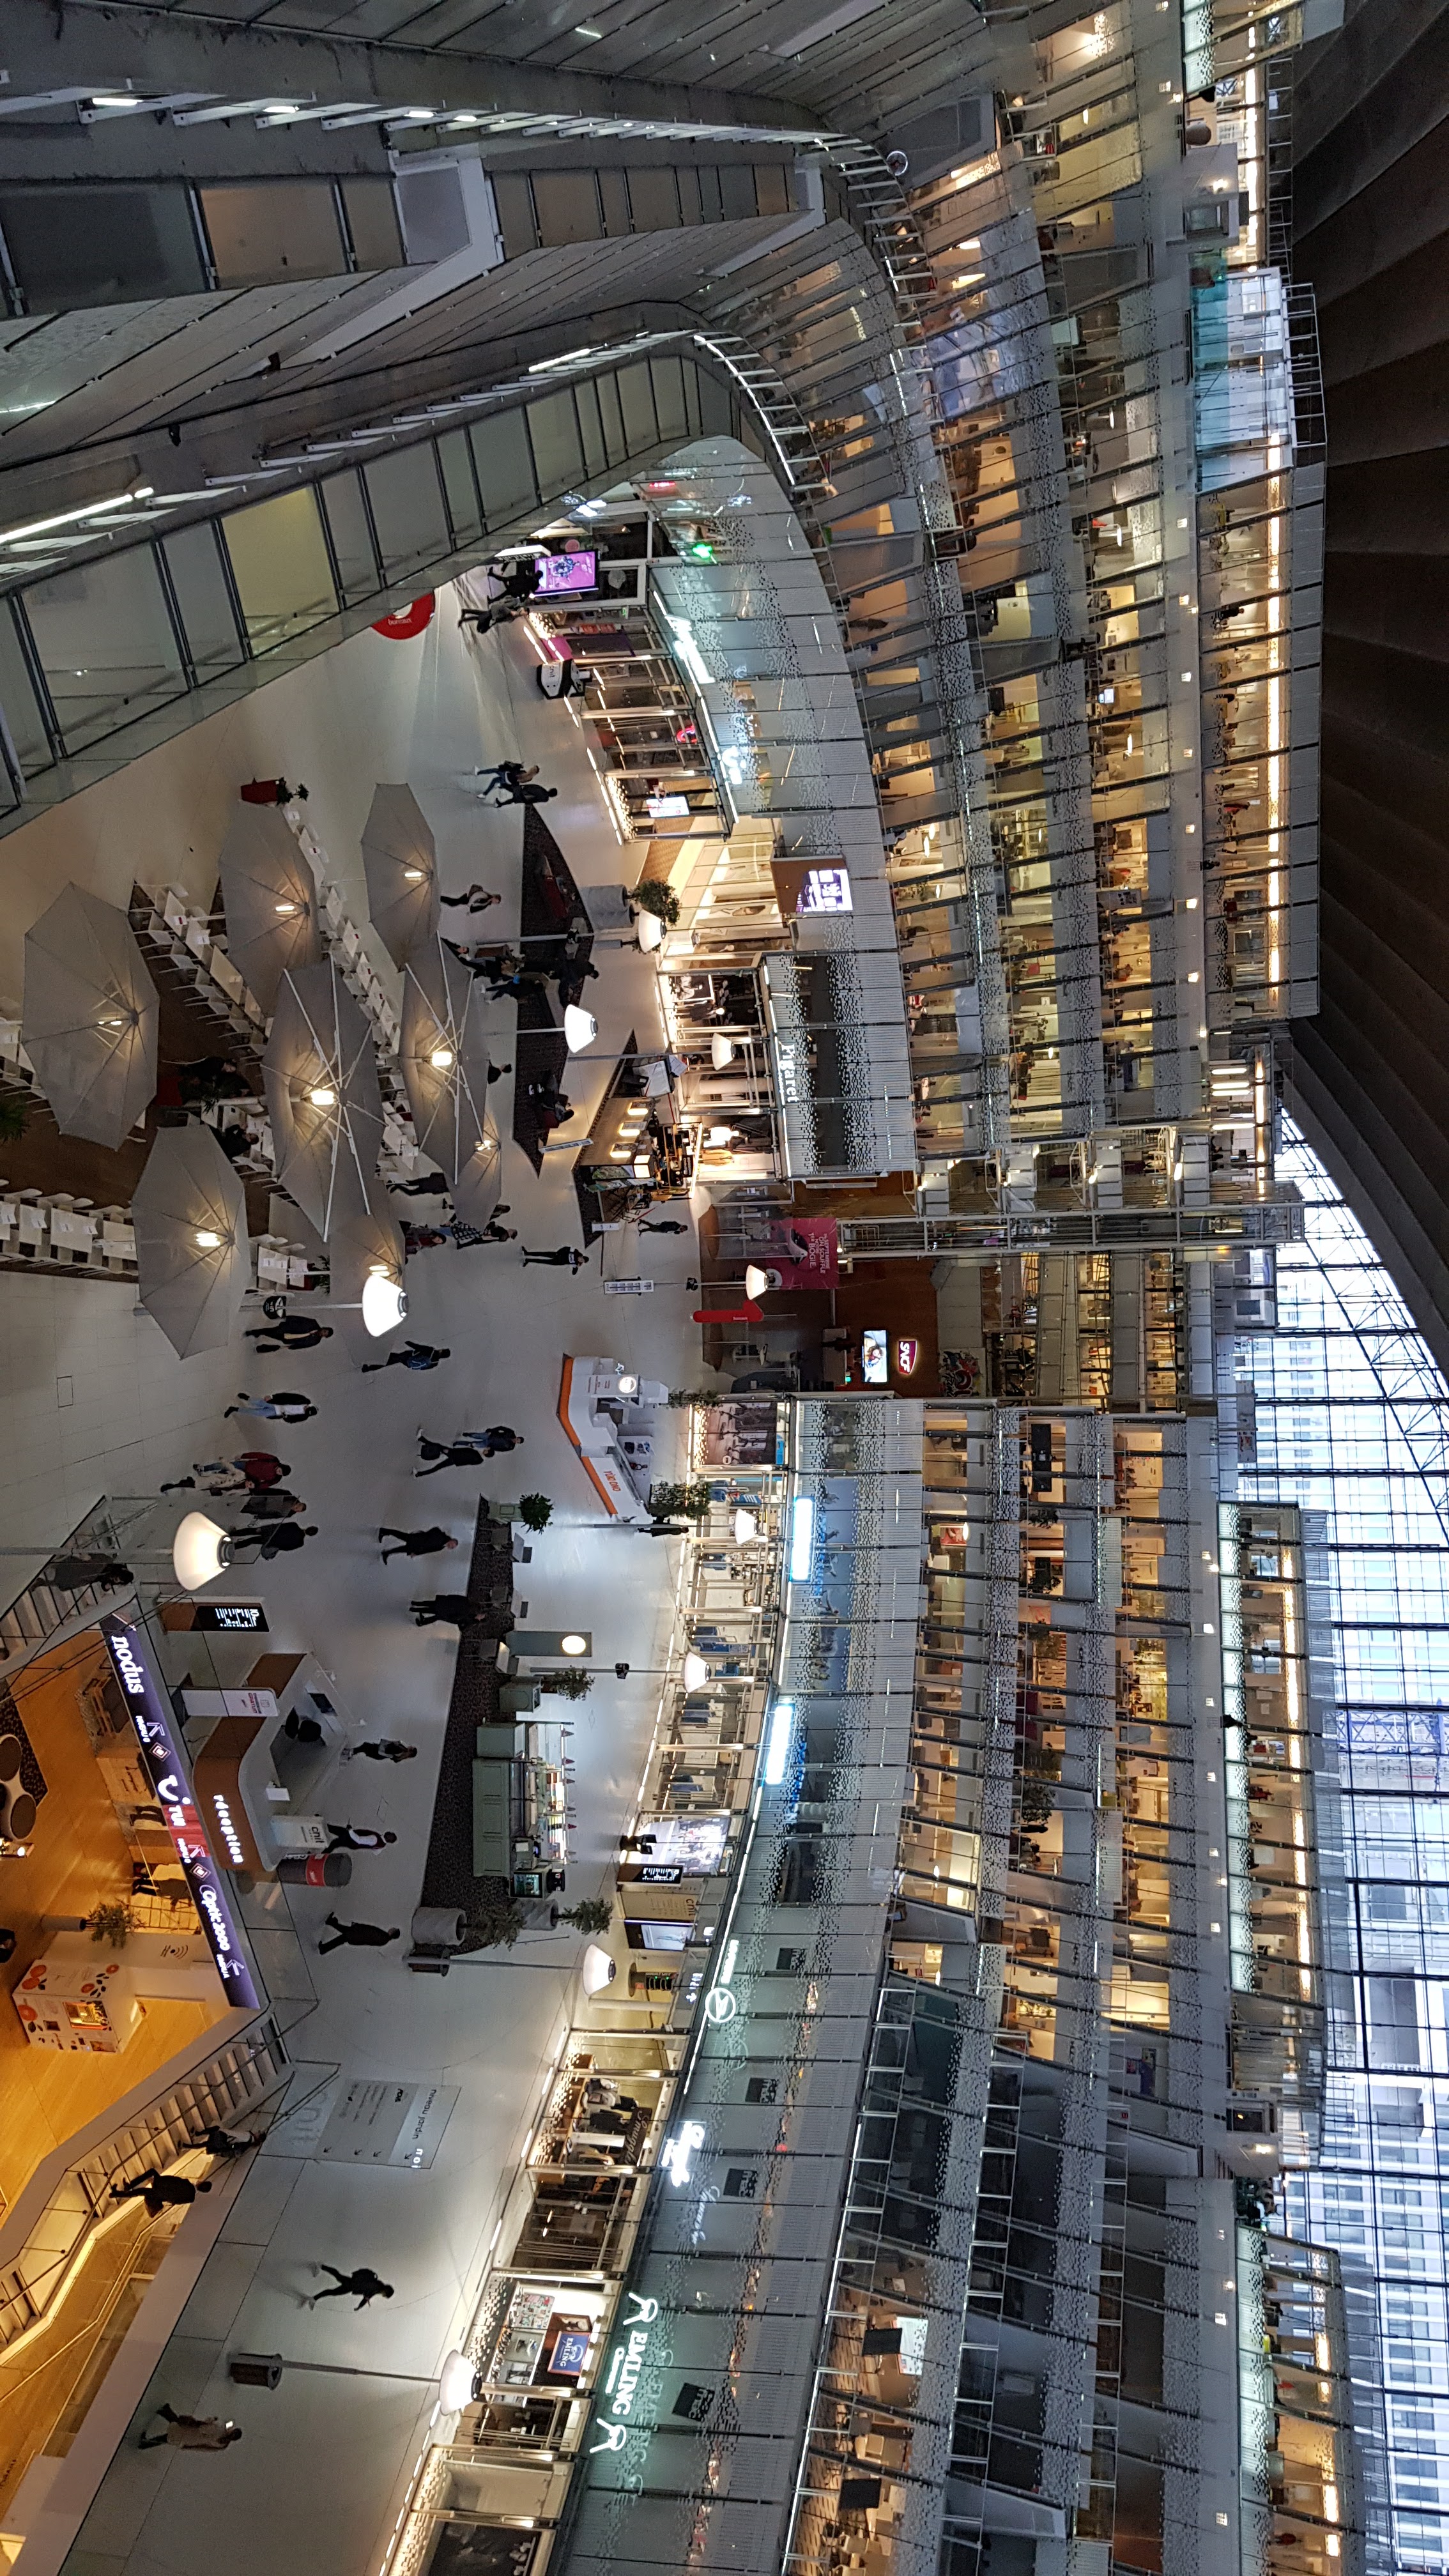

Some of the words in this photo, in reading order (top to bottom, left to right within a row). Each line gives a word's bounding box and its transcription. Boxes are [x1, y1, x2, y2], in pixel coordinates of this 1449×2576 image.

[779, 1044, 800, 1103] Figaret
[819, 1236, 824, 1246] ON
[900, 1342, 910, 1372] SNCF
[111, 1636, 145, 1694] nodus
[168, 1805, 186, 1827] TUI
[213, 1794, 245, 1864] réception
[311, 1827, 325, 1843] cnit
[201, 1890, 222, 1922] Optic
[213, 1922, 231, 1951] 2000
[420, 2089, 438, 2115] niveau
[411, 2116, 427, 2140] jardin
[560, 2338, 574, 2367] EMLING
[611, 2331, 648, 2416] EMLING
